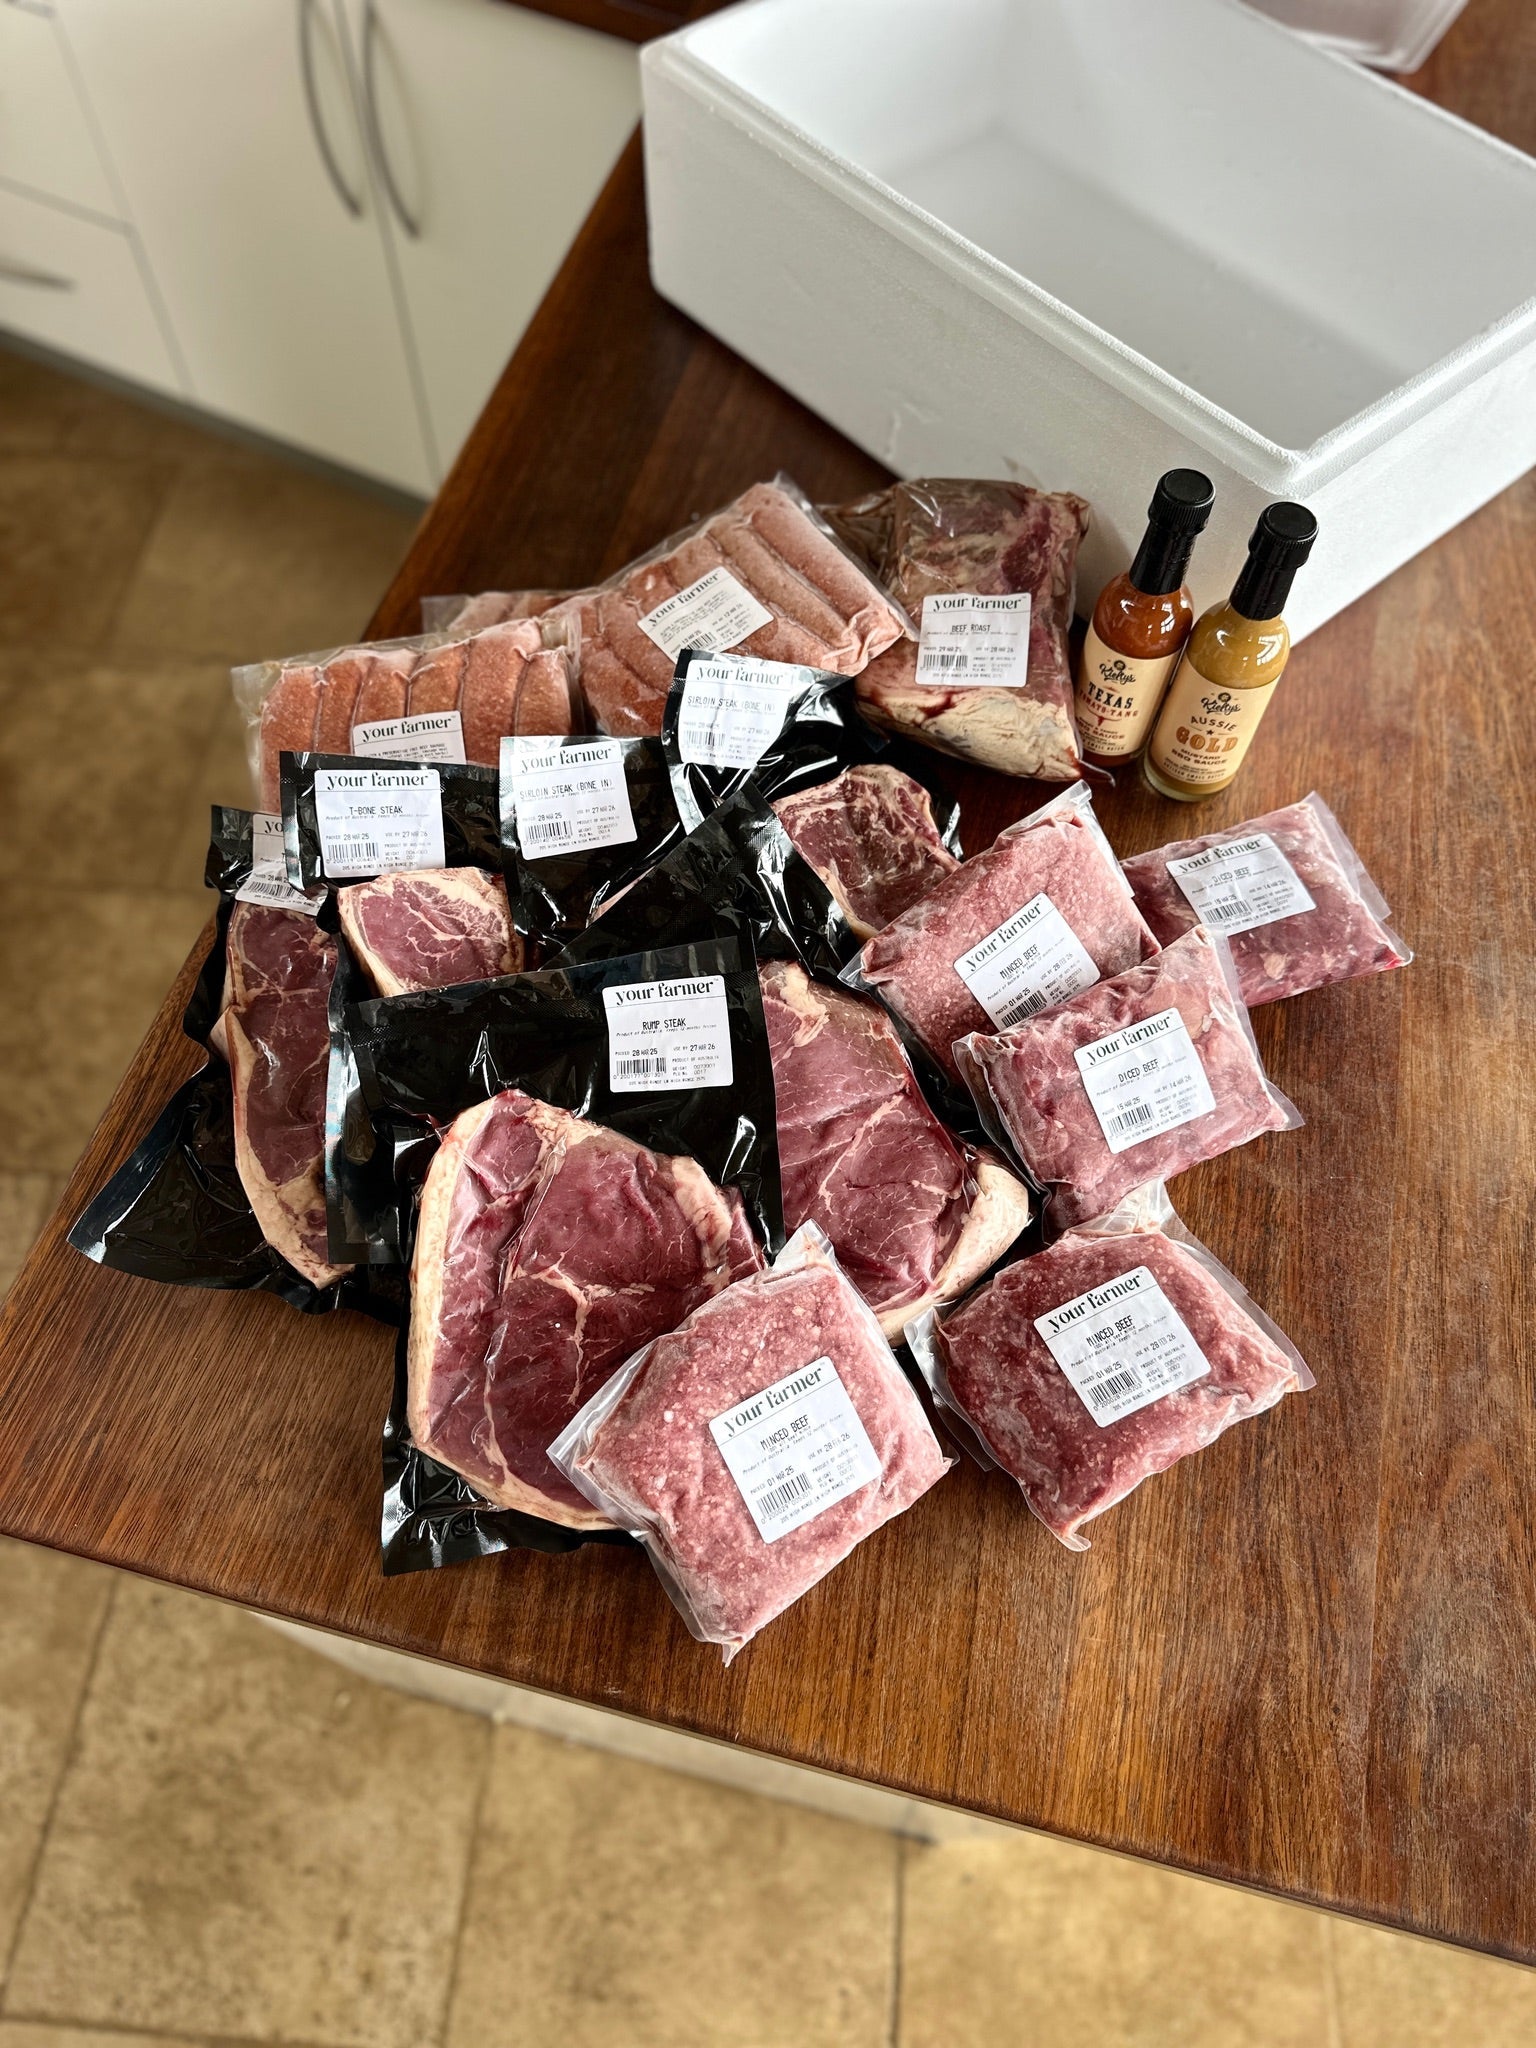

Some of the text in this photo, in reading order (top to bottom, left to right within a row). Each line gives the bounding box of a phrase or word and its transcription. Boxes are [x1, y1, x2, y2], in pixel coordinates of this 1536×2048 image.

[648, 601, 675, 627] your
[677, 573, 717, 604] farmer
[933, 597, 1021, 612] your farmer
[951, 624, 967, 633] BEEF
[970, 623, 991, 631] ROAST
[697, 667, 783, 684] your farmer
[687, 695, 716, 705] SIRLOIN
[1088, 682, 1133, 709] TEXAS
[362, 718, 451, 743] your farmer
[1191, 716, 1236, 731] AUSSIE
[1176, 726, 1238, 753] GOLD
[521, 748, 611, 773] your farmer
[327, 772, 428, 790] your farmer
[519, 787, 549, 800] SIRLOIN
[552, 784, 573, 795] STEAK
[576, 780, 597, 791] (BONE
[349, 805, 403, 815] T-BONE STEAK
[1179, 839, 1260, 873] your farmer
[1233, 866, 1249, 877] BEEF
[966, 903, 1040, 972] your farmer
[999, 943, 1038, 979] MINCED BEEF
[615, 981, 713, 1006] your farmer
[1008, 998, 1016, 1007] 01
[1022, 987, 1031, 996] 25
[642, 1018, 686, 1030] RUMP STEAK
[689, 1044, 698, 1052] 27
[1087, 1016, 1169, 1065] your farmer
[632, 1049, 640, 1057] 28
[649, 1047, 658, 1055] 25
[1118, 1058, 1158, 1083] DICED BEEF
[1116, 1102, 1124, 1110] 15
[1048, 1275, 1140, 1333] your farmer
[1086, 1315, 1133, 1346] MINCED BEEF
[1149, 1341, 1160, 1351] 28
[1166, 1332, 1176, 1342] 26
[1095, 1370, 1105, 1379] 01
[1112, 1360, 1122, 1371] 25
[724, 1368, 821, 1437] your farmer
[760, 1414, 808, 1450] MINCED BEEF
[823, 1441, 833, 1452] 28
[840, 1432, 850, 1442] 26
[766, 1477, 776, 1487] 01
[784, 1465, 794, 1476] 25
